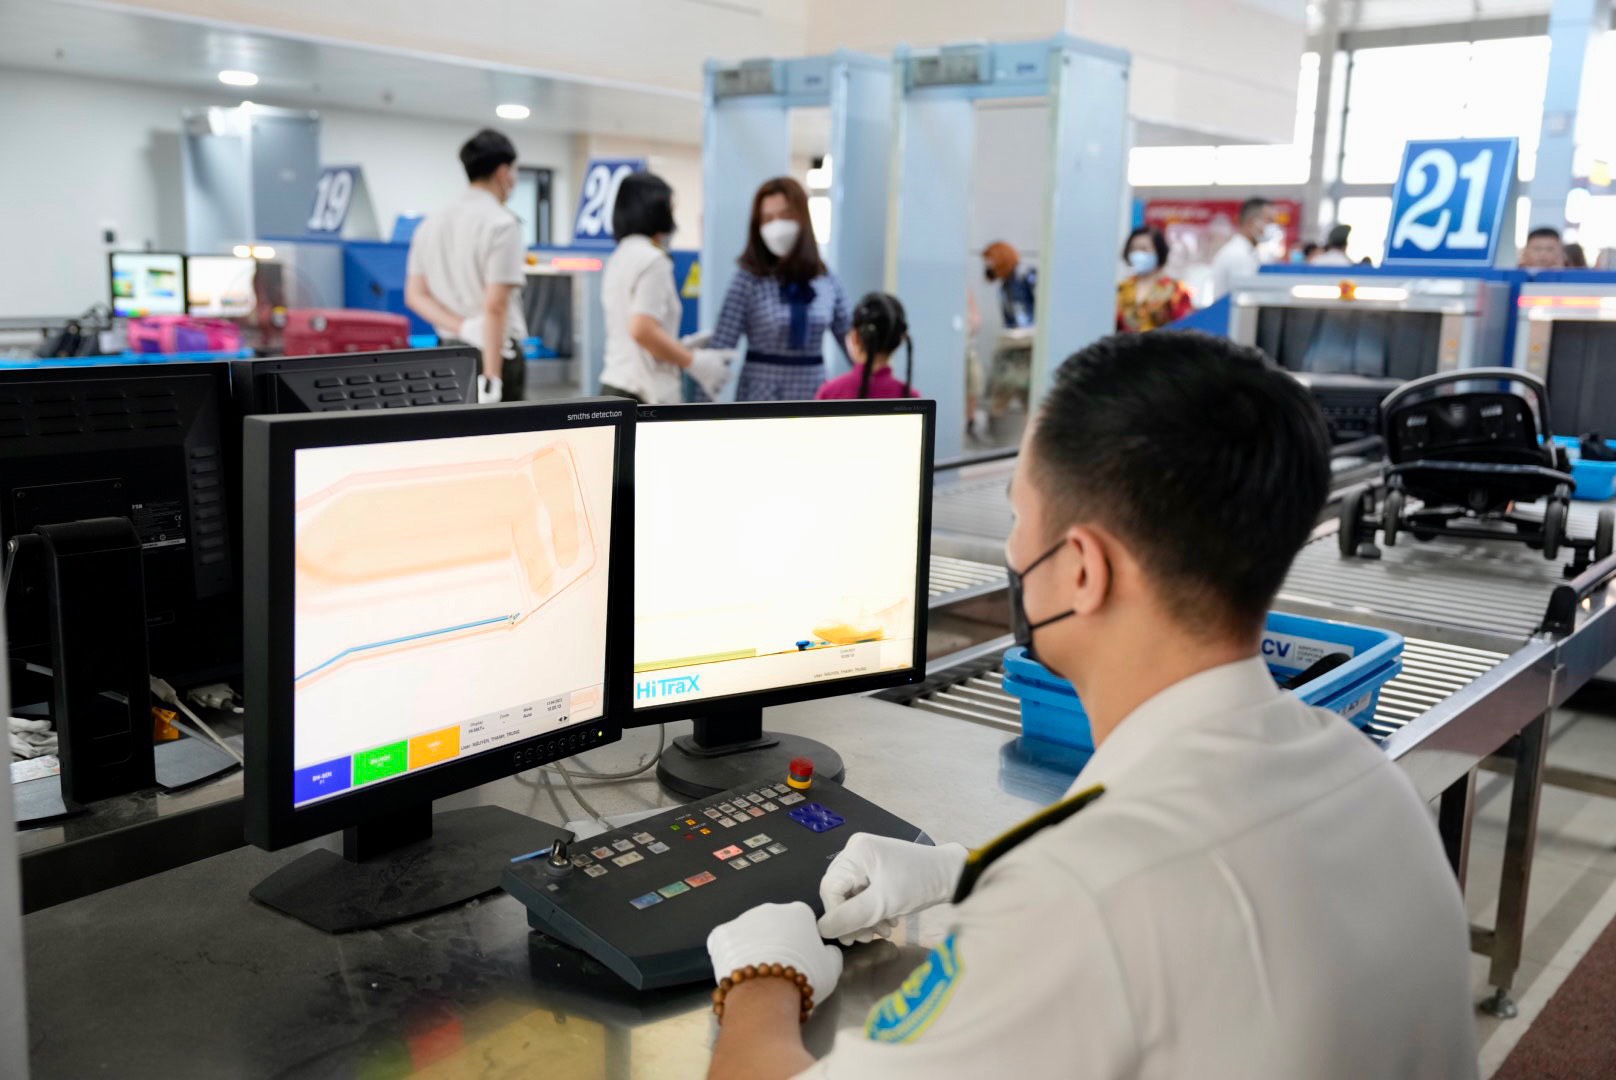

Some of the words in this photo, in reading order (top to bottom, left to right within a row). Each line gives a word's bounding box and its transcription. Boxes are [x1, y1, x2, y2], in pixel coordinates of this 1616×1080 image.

[307, 170, 353, 231] 19
[1392, 147, 1493, 252] 21
[567, 413, 590, 421] smiths
[591, 410, 623, 419] detection
[636, 674, 701, 700] HiTraX
